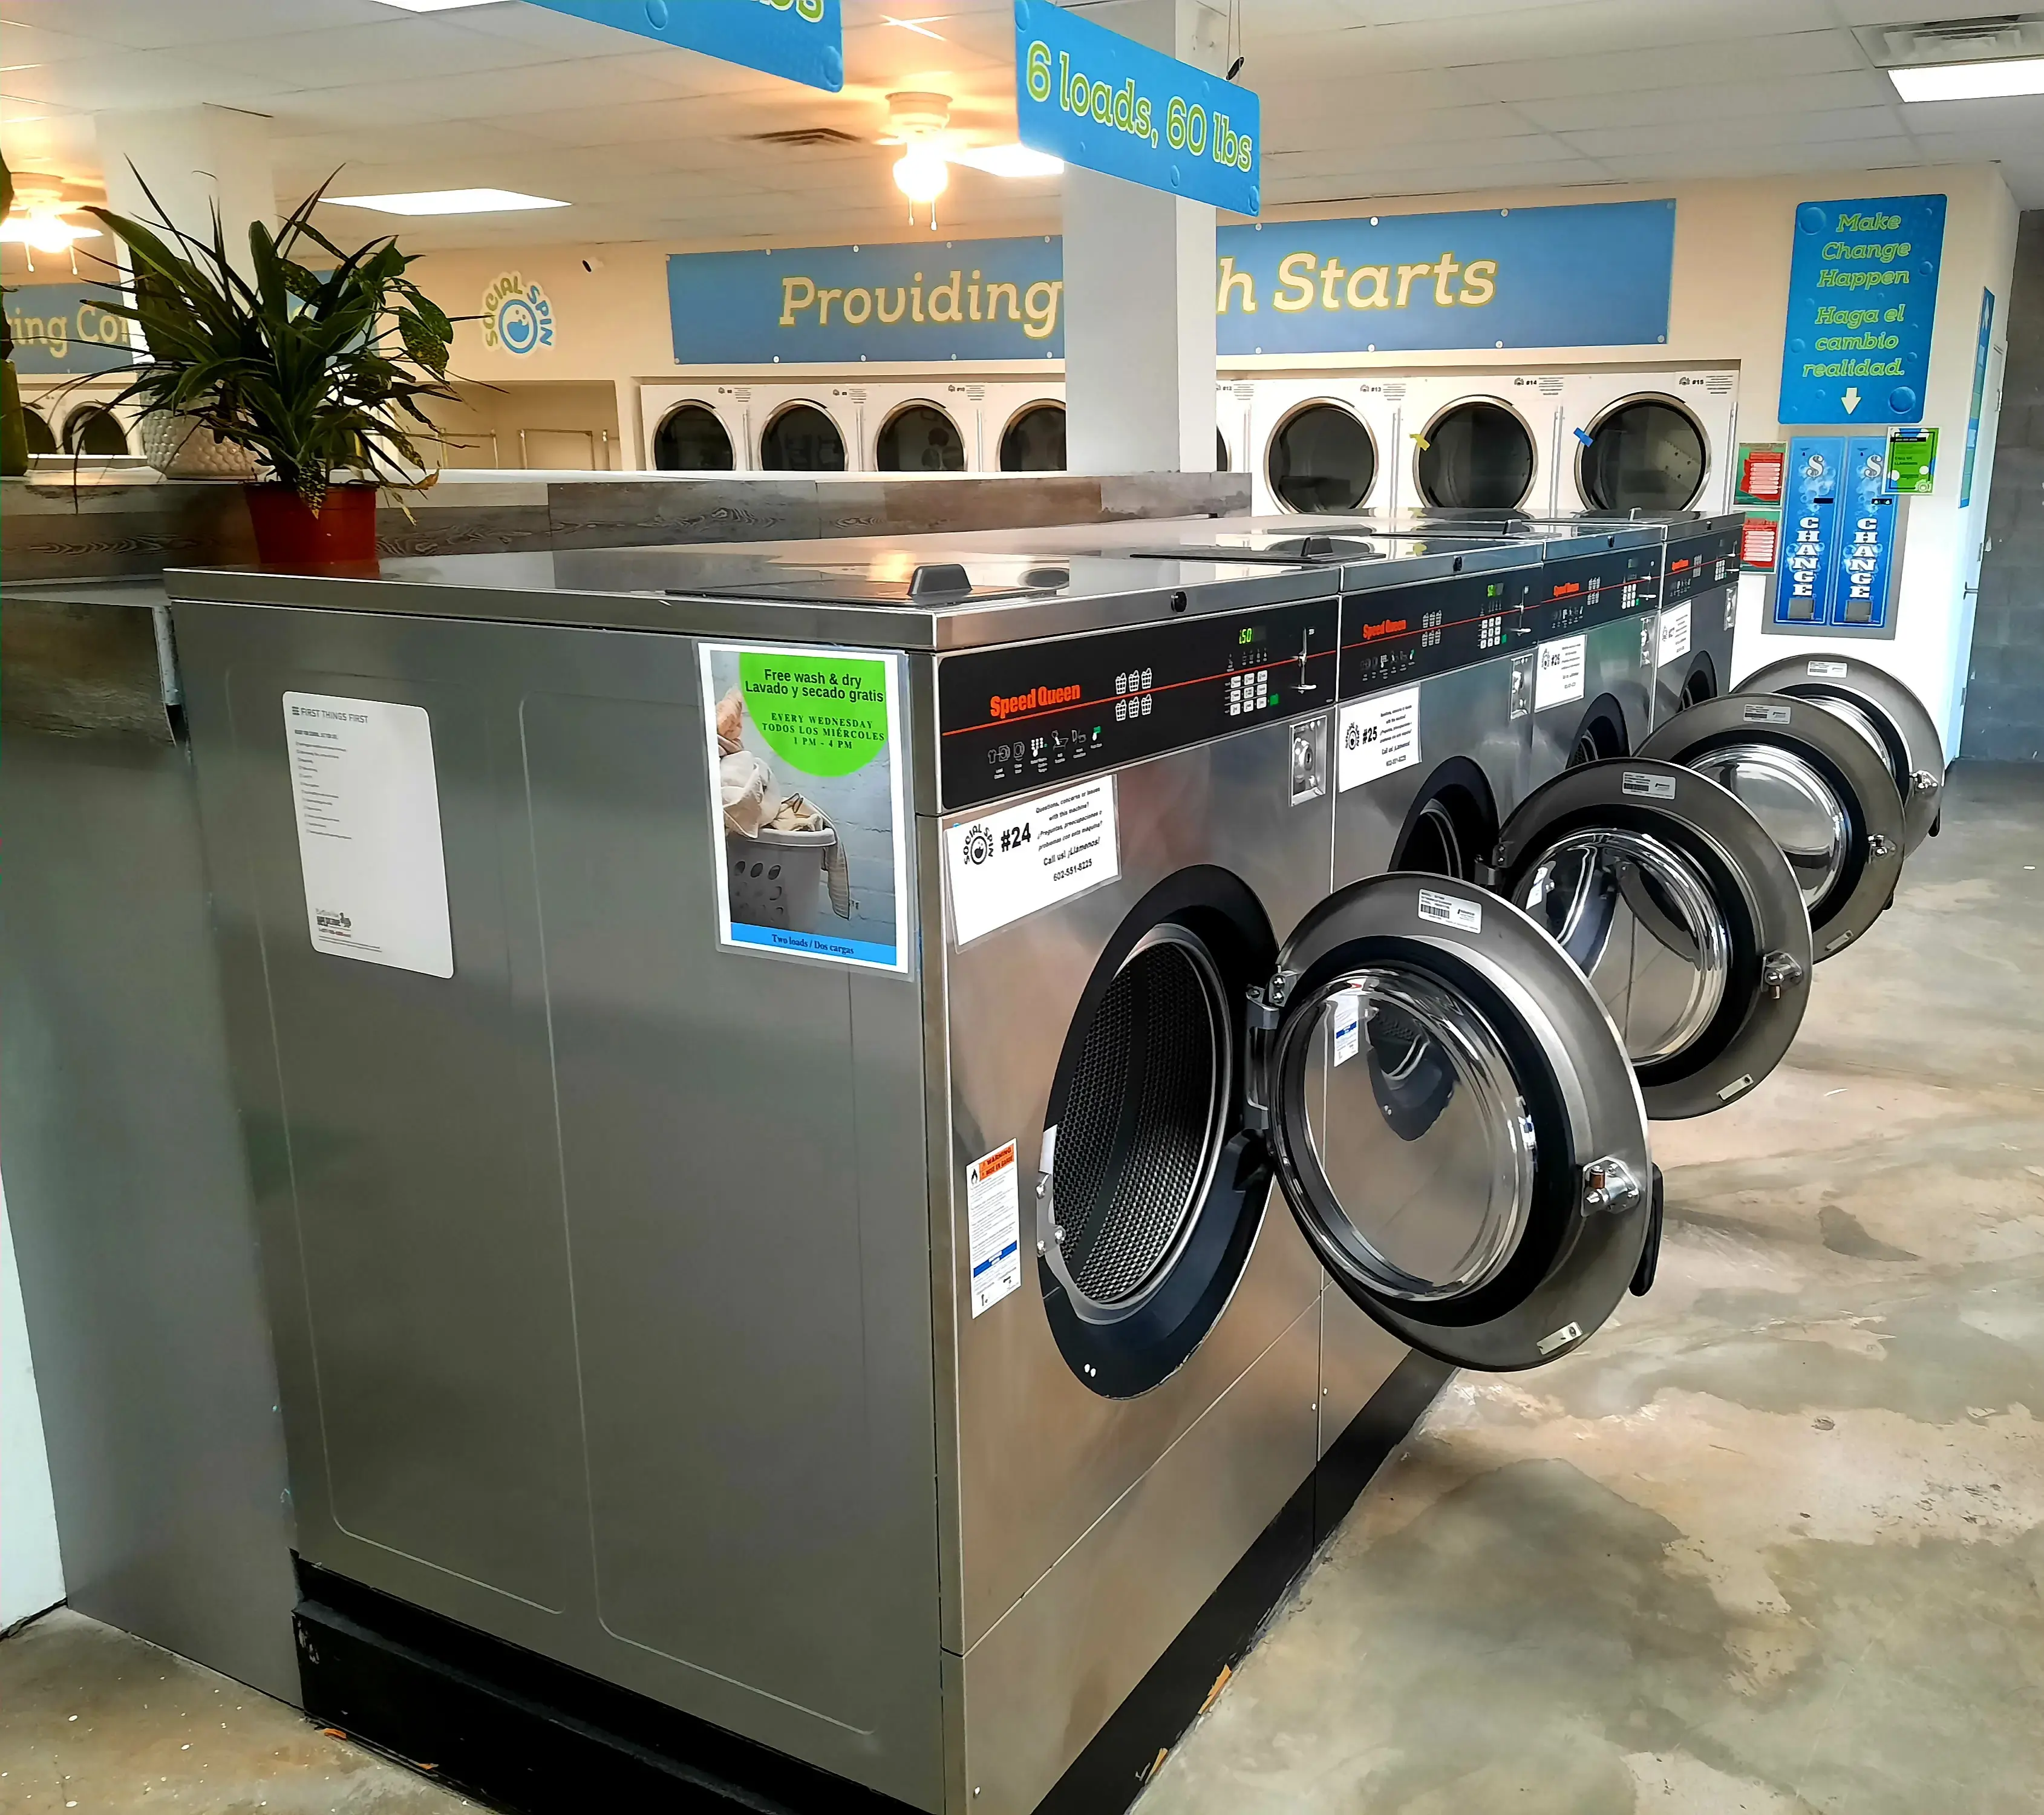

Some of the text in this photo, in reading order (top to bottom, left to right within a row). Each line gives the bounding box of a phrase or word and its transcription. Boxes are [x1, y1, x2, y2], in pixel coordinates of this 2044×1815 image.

[1027, 40, 1252, 172] 6 loads, 60 lbs
[1836, 212, 1901, 232] Make
[1822, 242, 1912, 263] Change
[1817, 269, 1909, 290] Happen
[779, 269, 1063, 339] Providing
[1273, 252, 1497, 312] Starts
[483, 276, 553, 347] SOCIAL SPIN
[1815, 304, 1905, 329] Haga el
[7, 307, 68, 358] ing
[1815, 332, 1899, 351] cambio
[1803, 358, 1905, 377] realidad.
[1792, 517, 1820, 596] CHANGE
[1849, 518, 1877, 598] CHANGE
[765, 669, 862, 690] Free wash & dry
[745, 681, 884, 703] Lavado y secado gratis
[990, 684, 1080, 719] Speed Queen
[321, 710, 347, 721] THINGS
[348, 713, 368, 723] FIRST
[771, 713, 872, 729] EVERY WEDNESDAY
[762, 723, 884, 741] TODOS LOS MIÉRCOLES
[1362, 726, 1377, 744] #25
[802, 737, 817, 746] PM
[838, 741, 852, 750] PM
[963, 823, 993, 865] SOCIAL SPIN
[1001, 822, 1031, 852] #24
[1043, 855, 1056, 866] Call
[1057, 850, 1066, 860] us!
[1053, 858, 1092, 881] 602-551-8225
[772, 934, 787, 944] Two
[789, 937, 808, 948] loads
[814, 941, 829, 952] Dos
[829, 944, 854, 955] cargas
